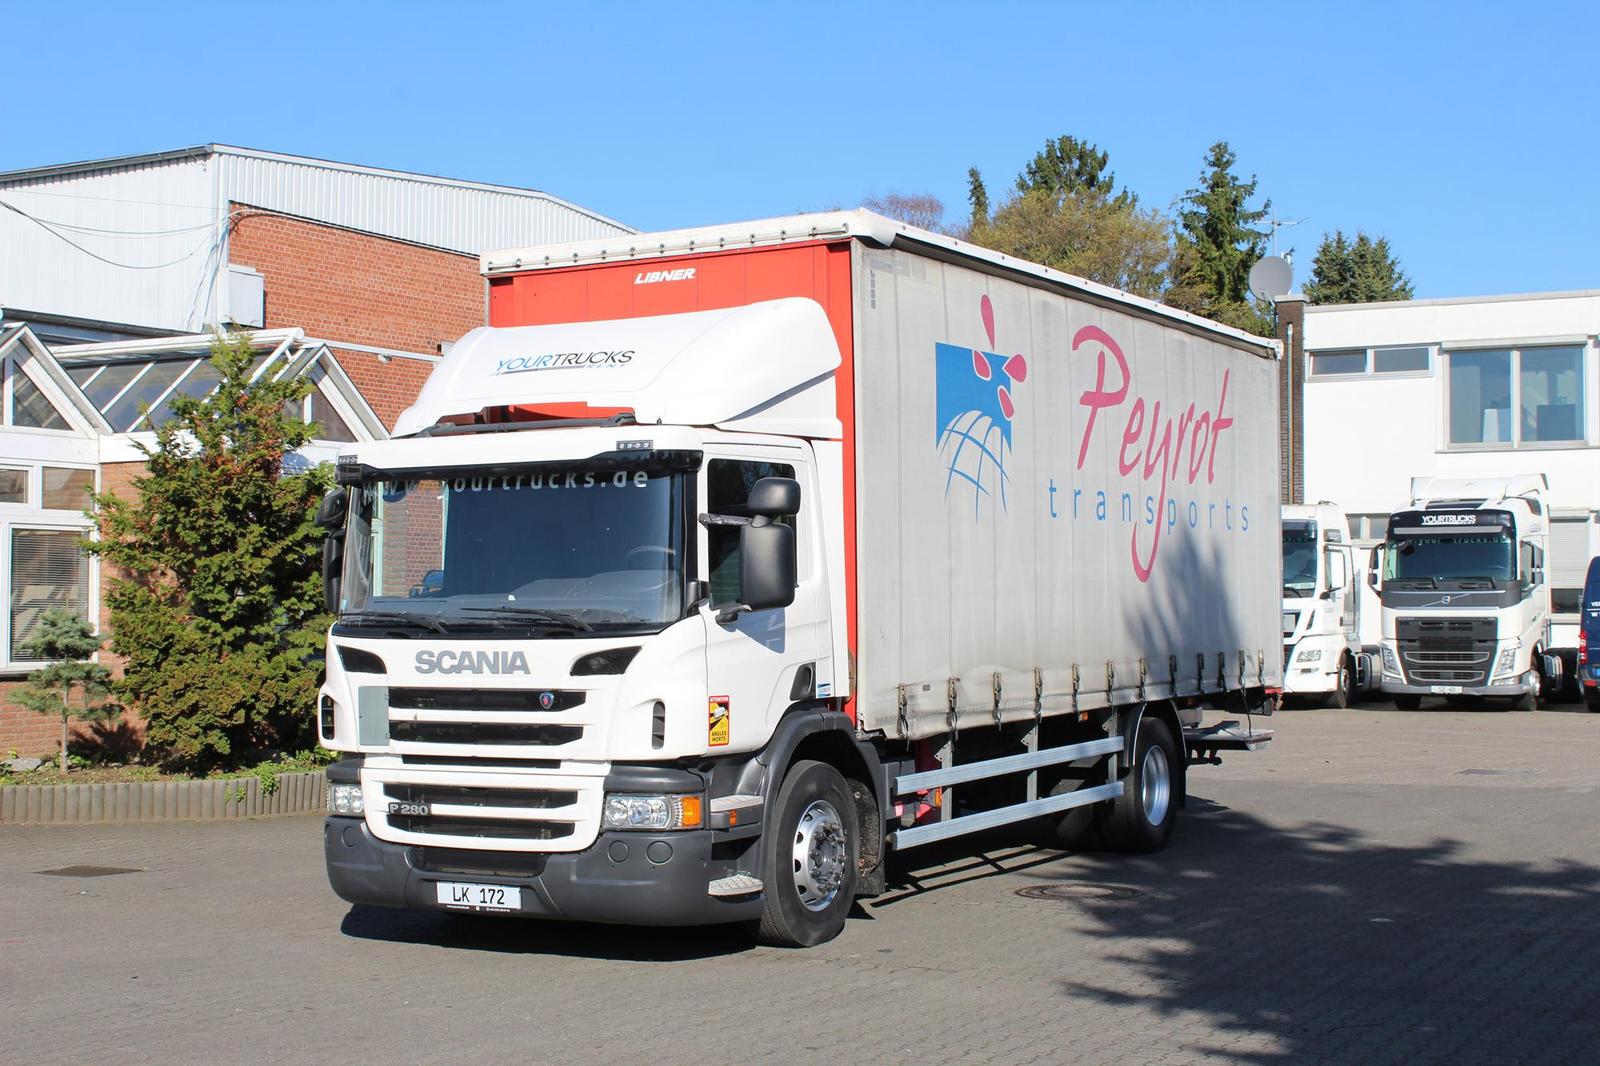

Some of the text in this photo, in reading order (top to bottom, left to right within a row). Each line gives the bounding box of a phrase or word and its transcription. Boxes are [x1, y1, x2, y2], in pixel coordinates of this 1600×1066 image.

[634, 267, 697, 285] LIBNER
[496, 350, 636, 372] YOURTRUCKS
[1072, 324, 1234, 583] Peyrot
[1049, 478, 1249, 535] transports
[1421, 514, 1477, 525] YOURTRUCKS
[414, 650, 532, 675] SCANIA
[389, 803, 429, 816] P 280
[452, 886, 505, 905] LK 172
